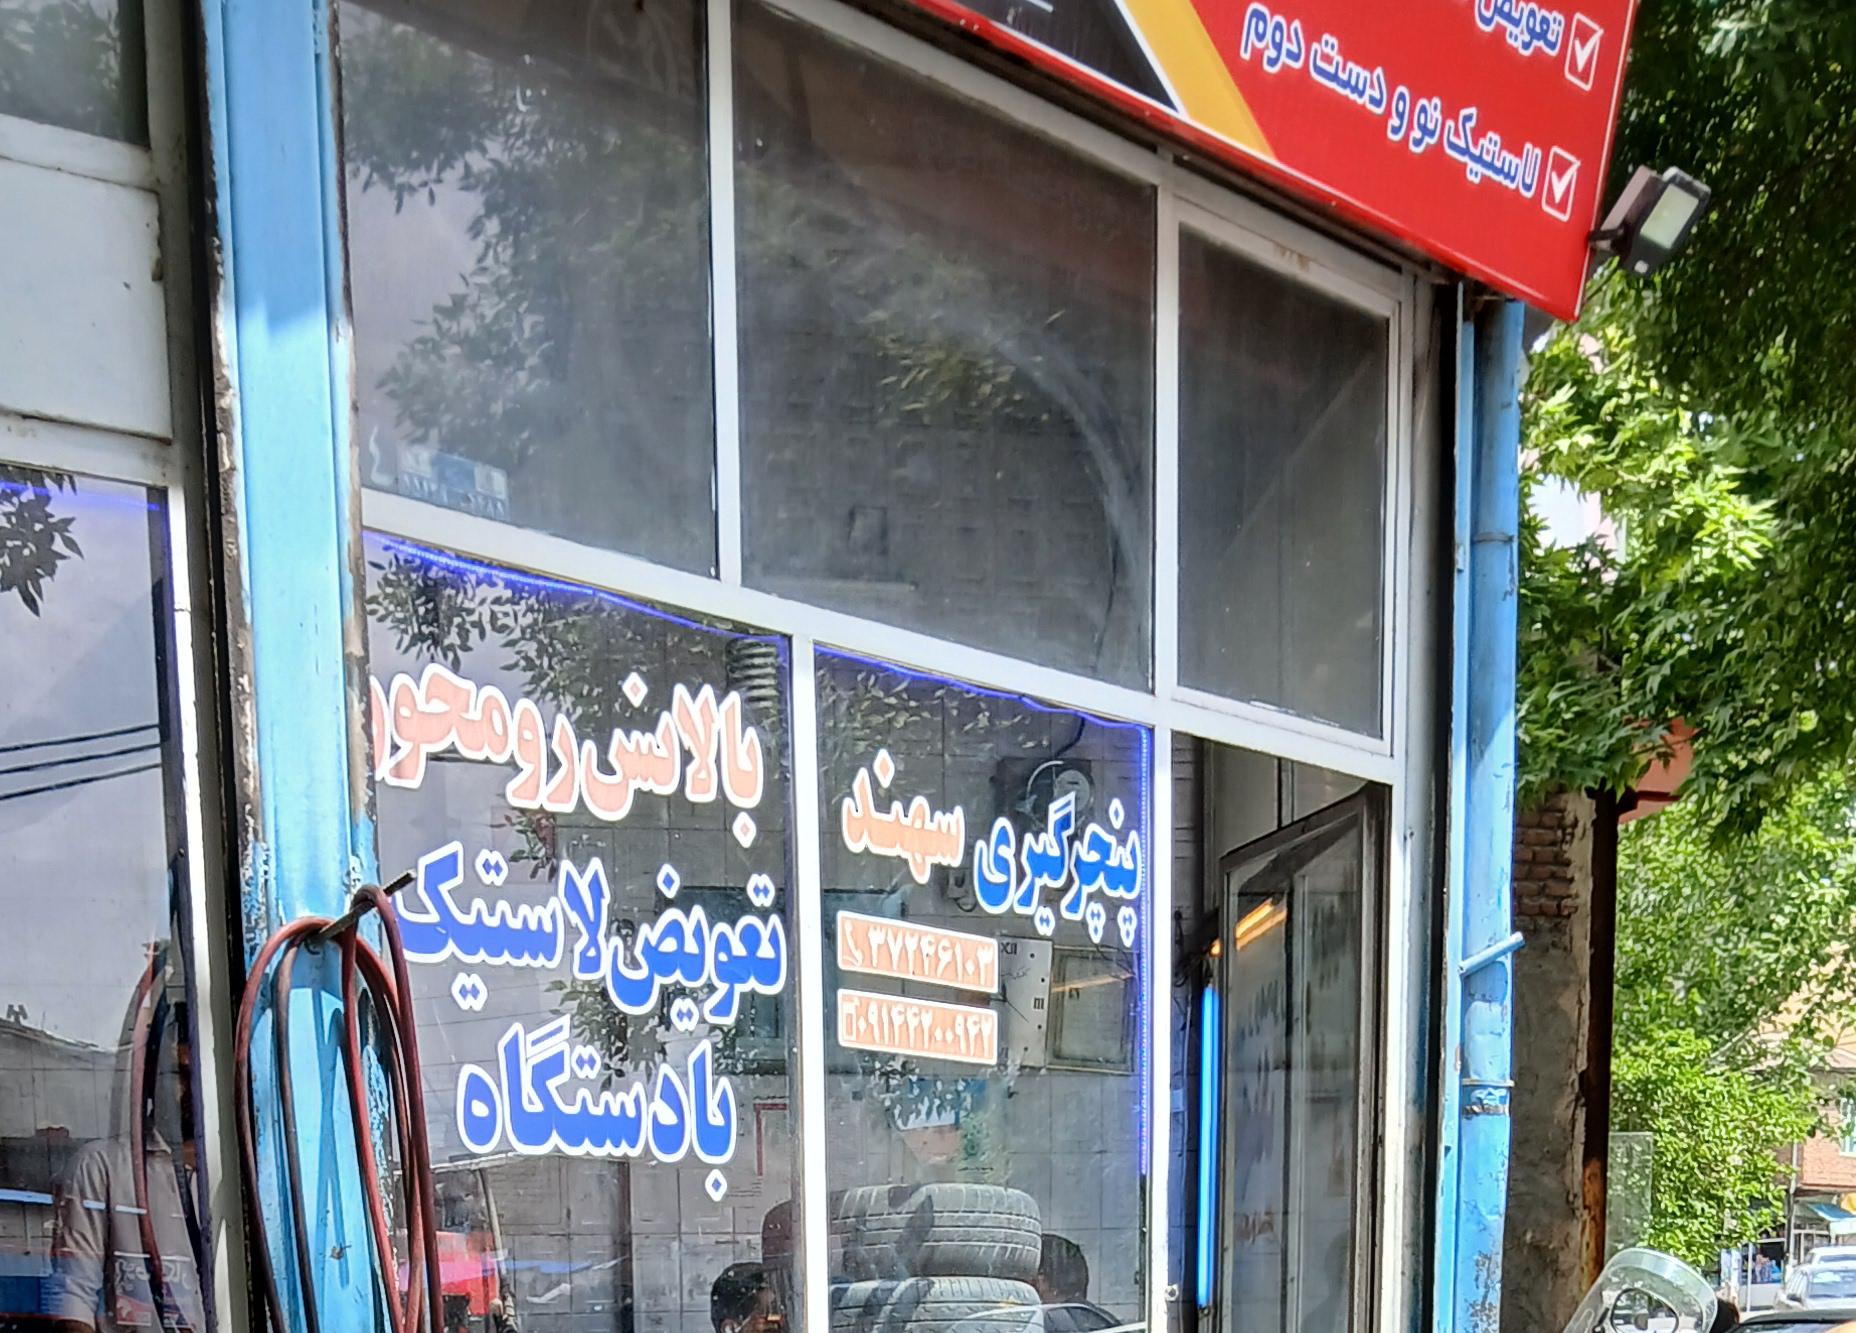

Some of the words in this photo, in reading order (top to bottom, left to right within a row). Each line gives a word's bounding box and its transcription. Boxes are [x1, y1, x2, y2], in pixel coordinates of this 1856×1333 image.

[1240, 4, 1304, 73] دوم
[1309, 33, 1387, 115] دست
[1388, 85, 1409, 140] و
[1408, 97, 1441, 153] نو
[1445, 107, 1541, 198] لاستیک
[581, 671, 763, 848] بالانس
[842, 749, 965, 884] سهند
[974, 792, 1141, 946] پنچرگیری
[394, 840, 609, 1011] لاستیک
[605, 863, 787, 1031] تعویض
